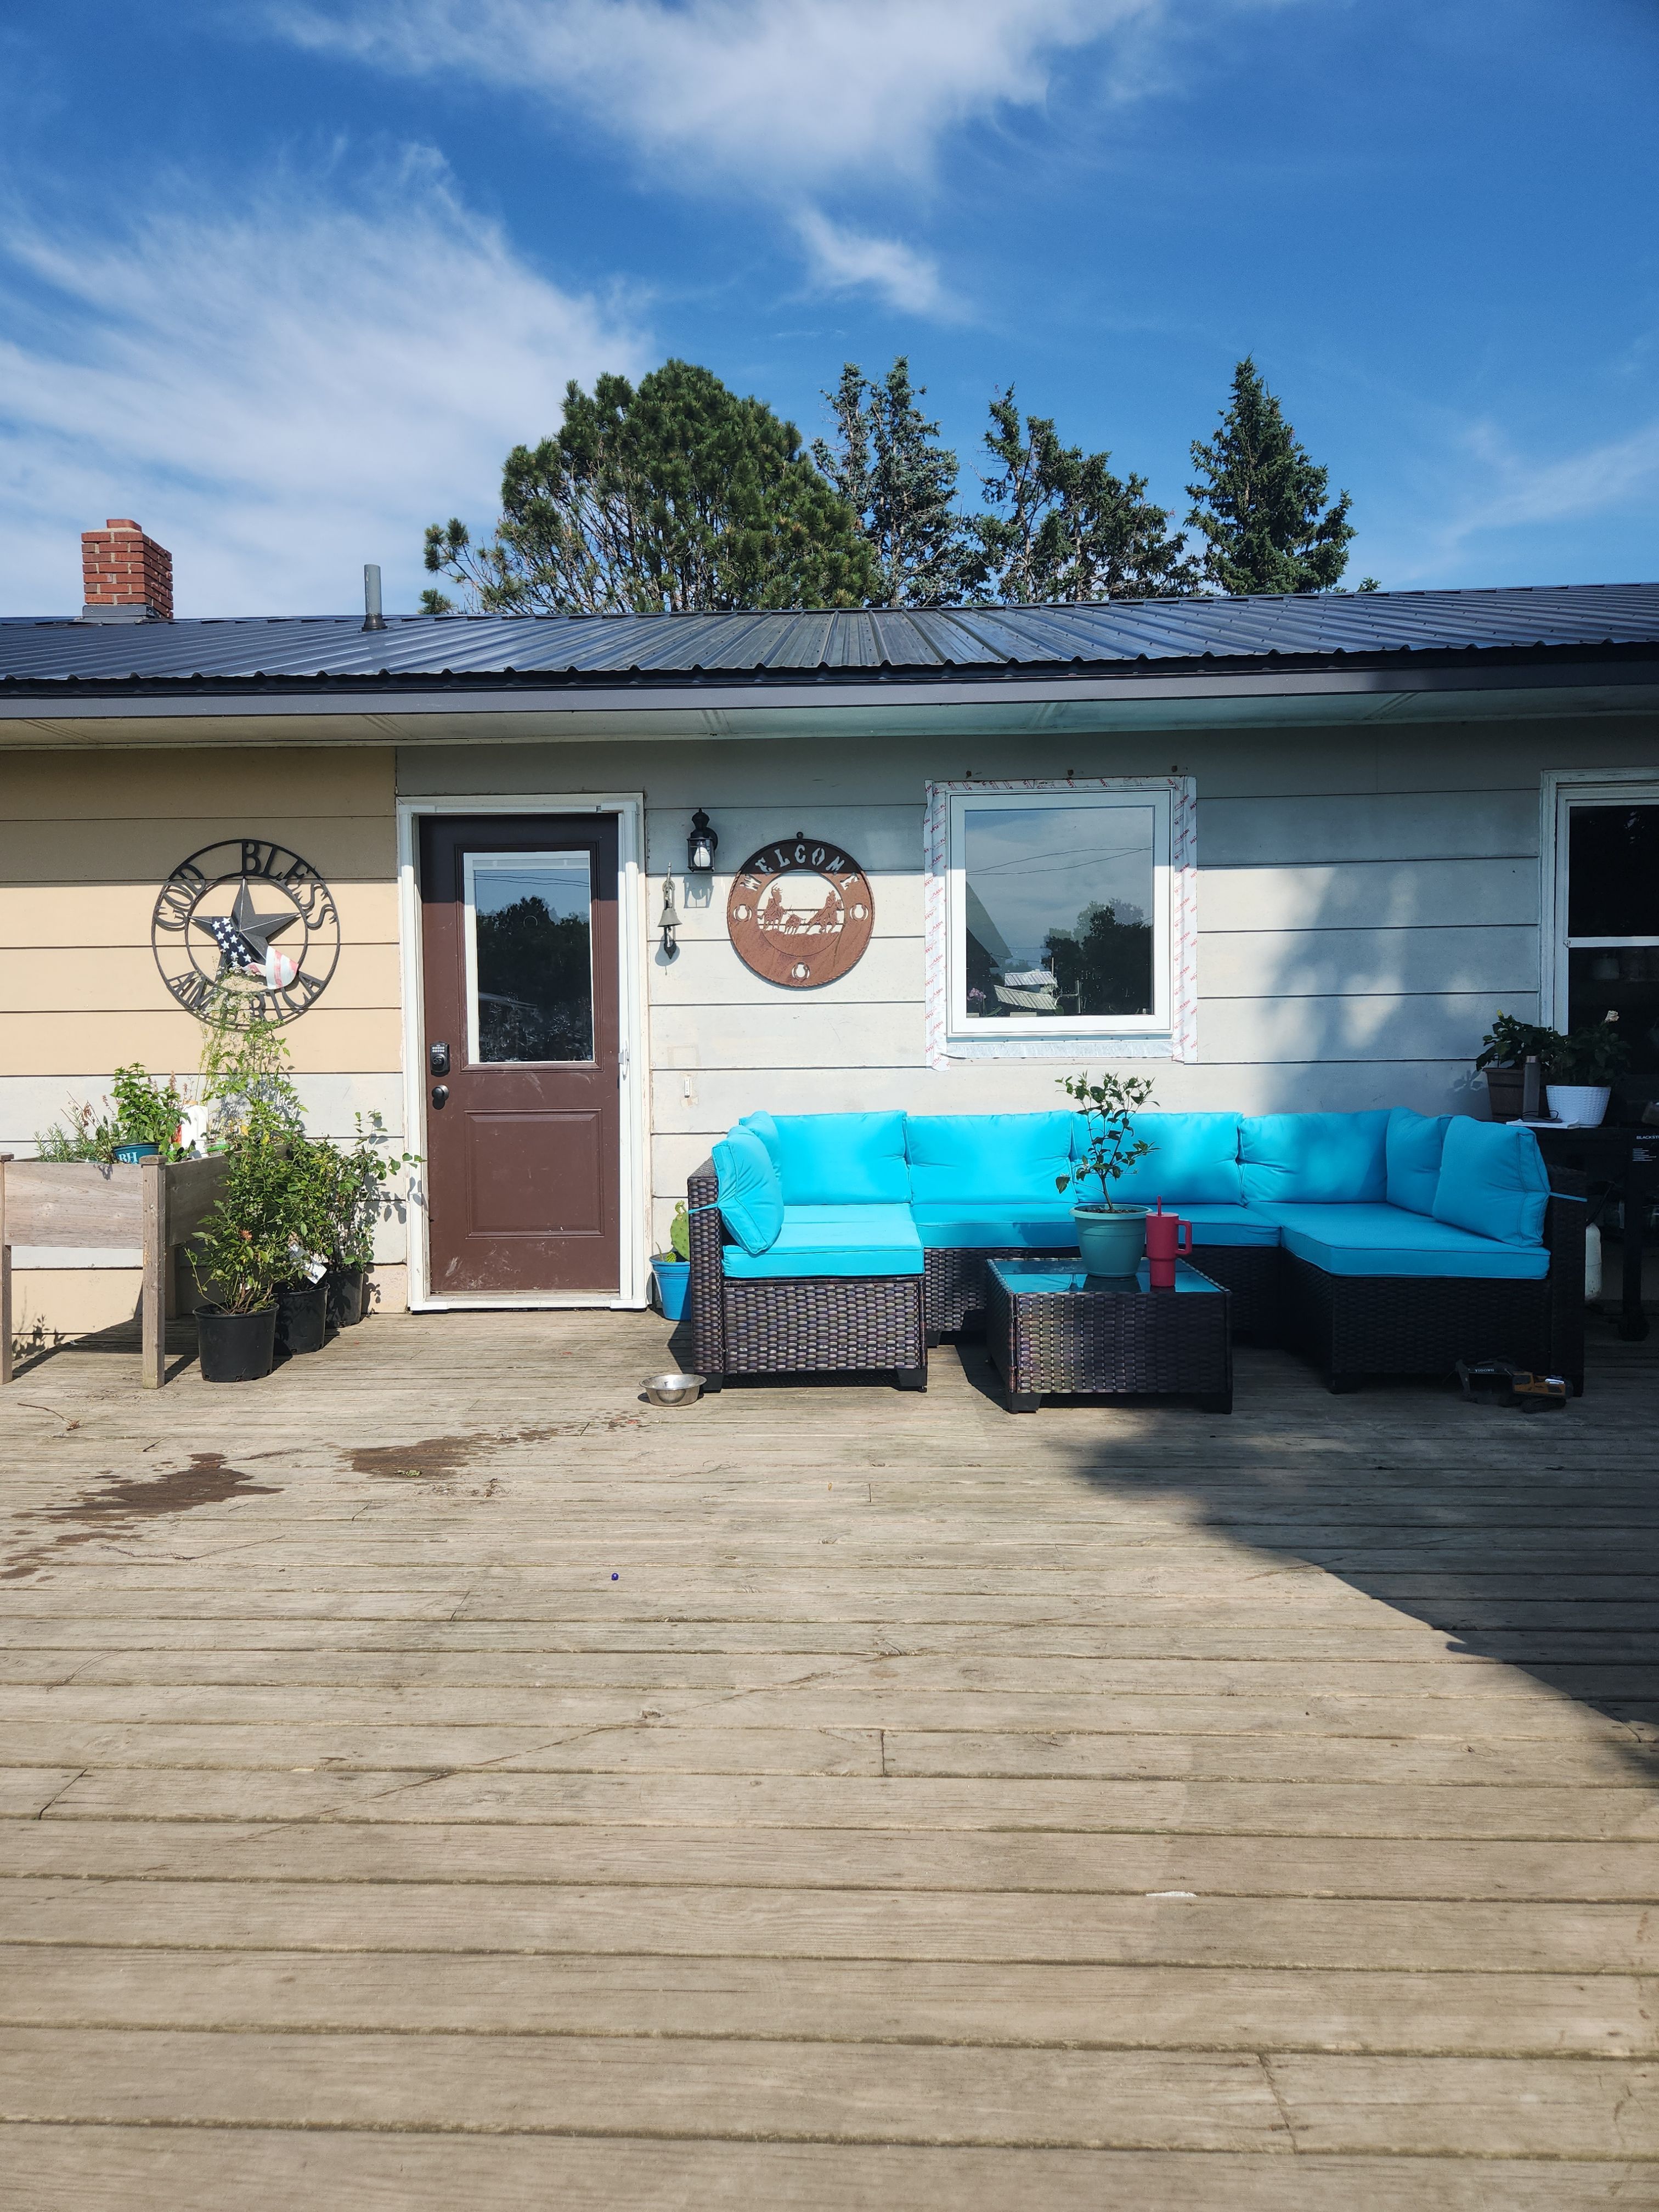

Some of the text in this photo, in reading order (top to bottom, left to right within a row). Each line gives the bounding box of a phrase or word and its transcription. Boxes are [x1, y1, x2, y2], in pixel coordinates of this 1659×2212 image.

[155, 841, 337, 931] GOD BLESS
[740, 844, 860, 891] WELCOME
[168, 970, 324, 1025] AMERICA
[119, 1152, 138, 1163] BH
